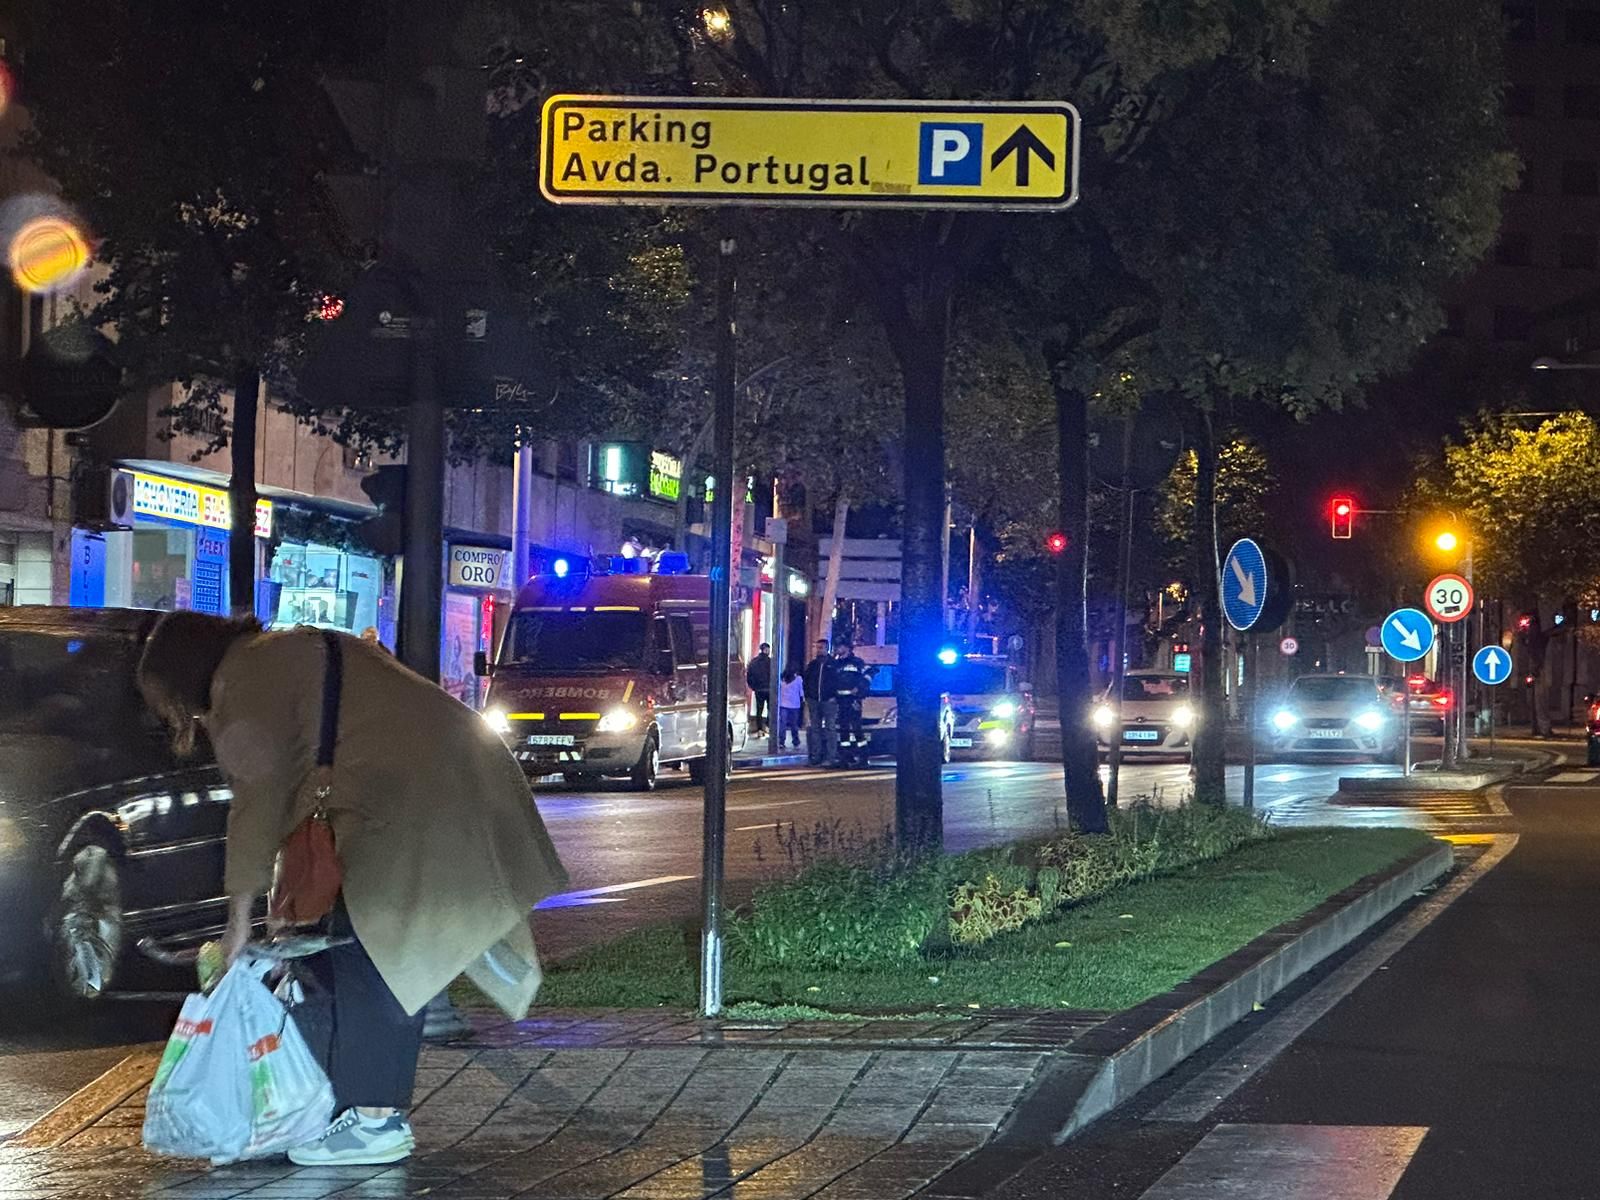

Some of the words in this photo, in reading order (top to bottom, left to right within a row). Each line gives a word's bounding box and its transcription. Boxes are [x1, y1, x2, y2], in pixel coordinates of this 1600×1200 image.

[562, 111, 712, 149] Parking
[931, 129, 970, 176] P
[561, 151, 672, 183] Avda.
[695, 153, 870, 191] Portugal
[454, 549, 500, 566] COMPRO
[461, 565, 495, 584] ORO
[1435, 588, 1463, 605] 30
[1283, 642, 1295, 651] 30
